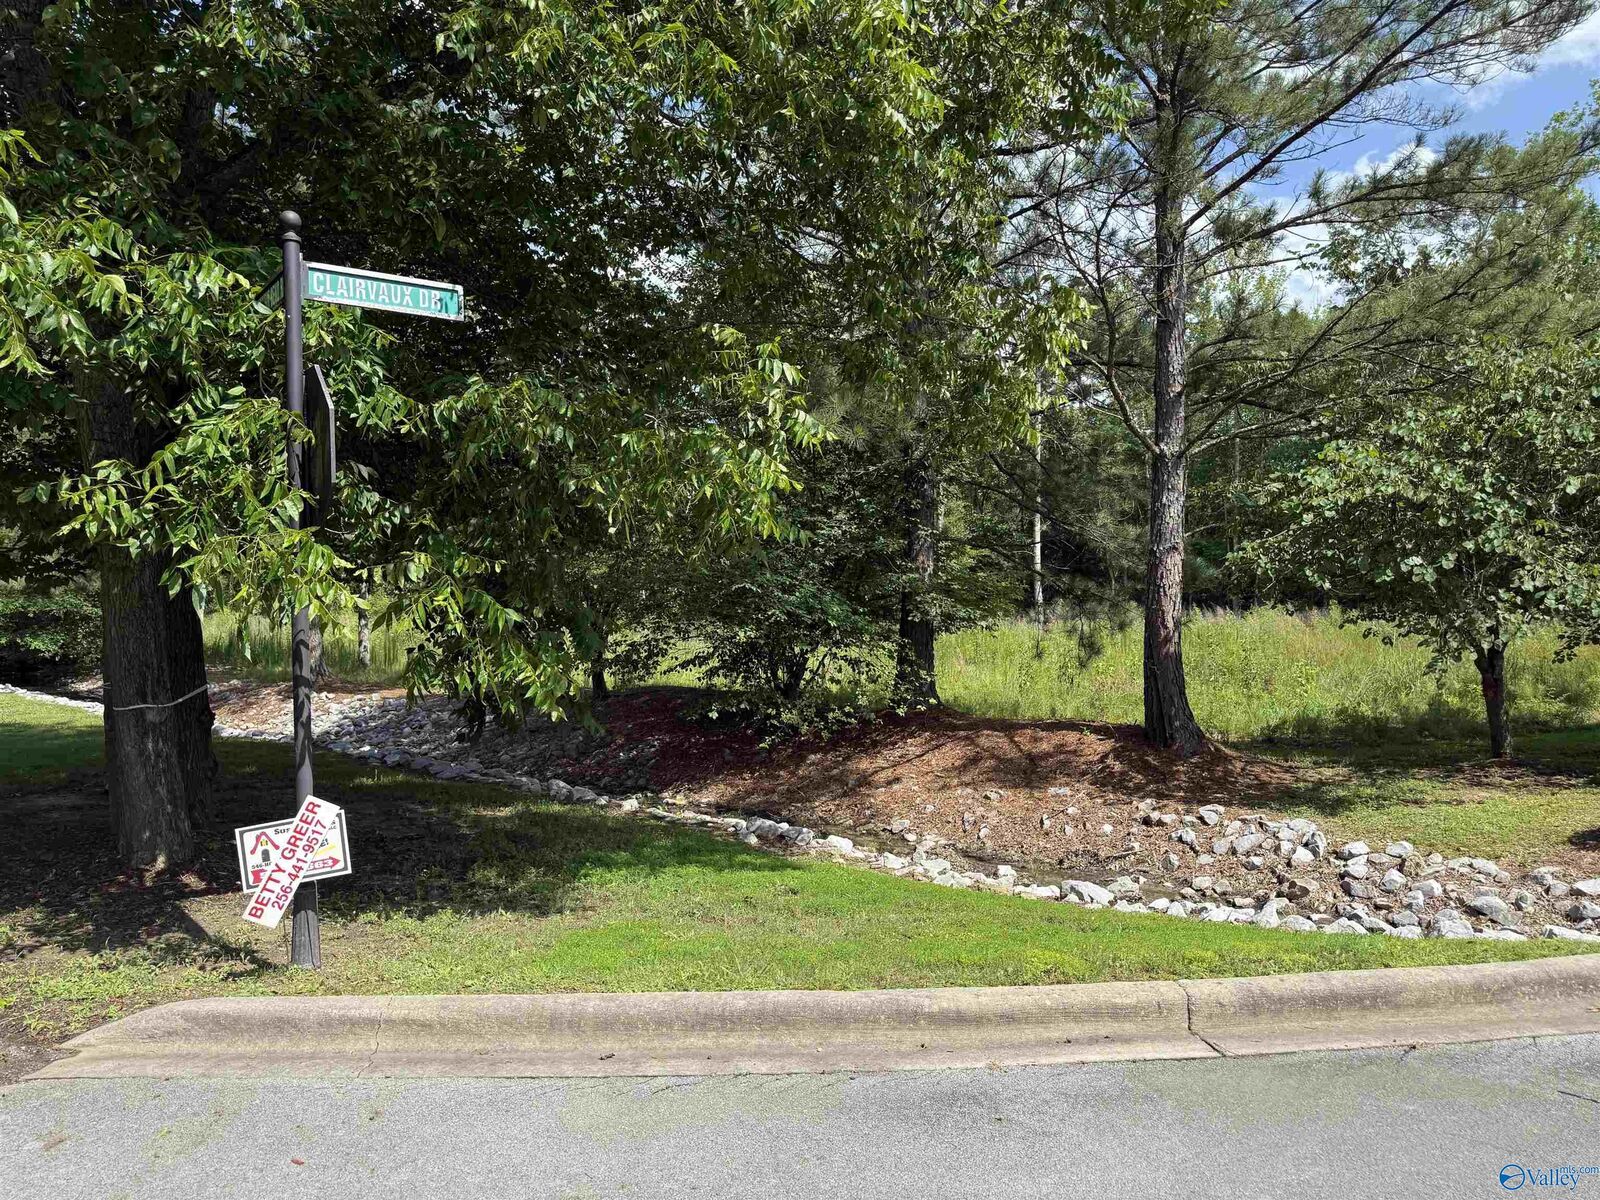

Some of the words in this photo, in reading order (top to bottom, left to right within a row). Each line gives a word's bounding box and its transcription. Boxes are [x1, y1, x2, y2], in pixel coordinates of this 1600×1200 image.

[312, 272, 413, 307] CLAIRVAUX
[419, 288, 442, 310] DR
[248, 863, 286, 919] BETTY
[281, 801, 321, 860] GREER
[272, 819, 326, 911] 256-441-9517
